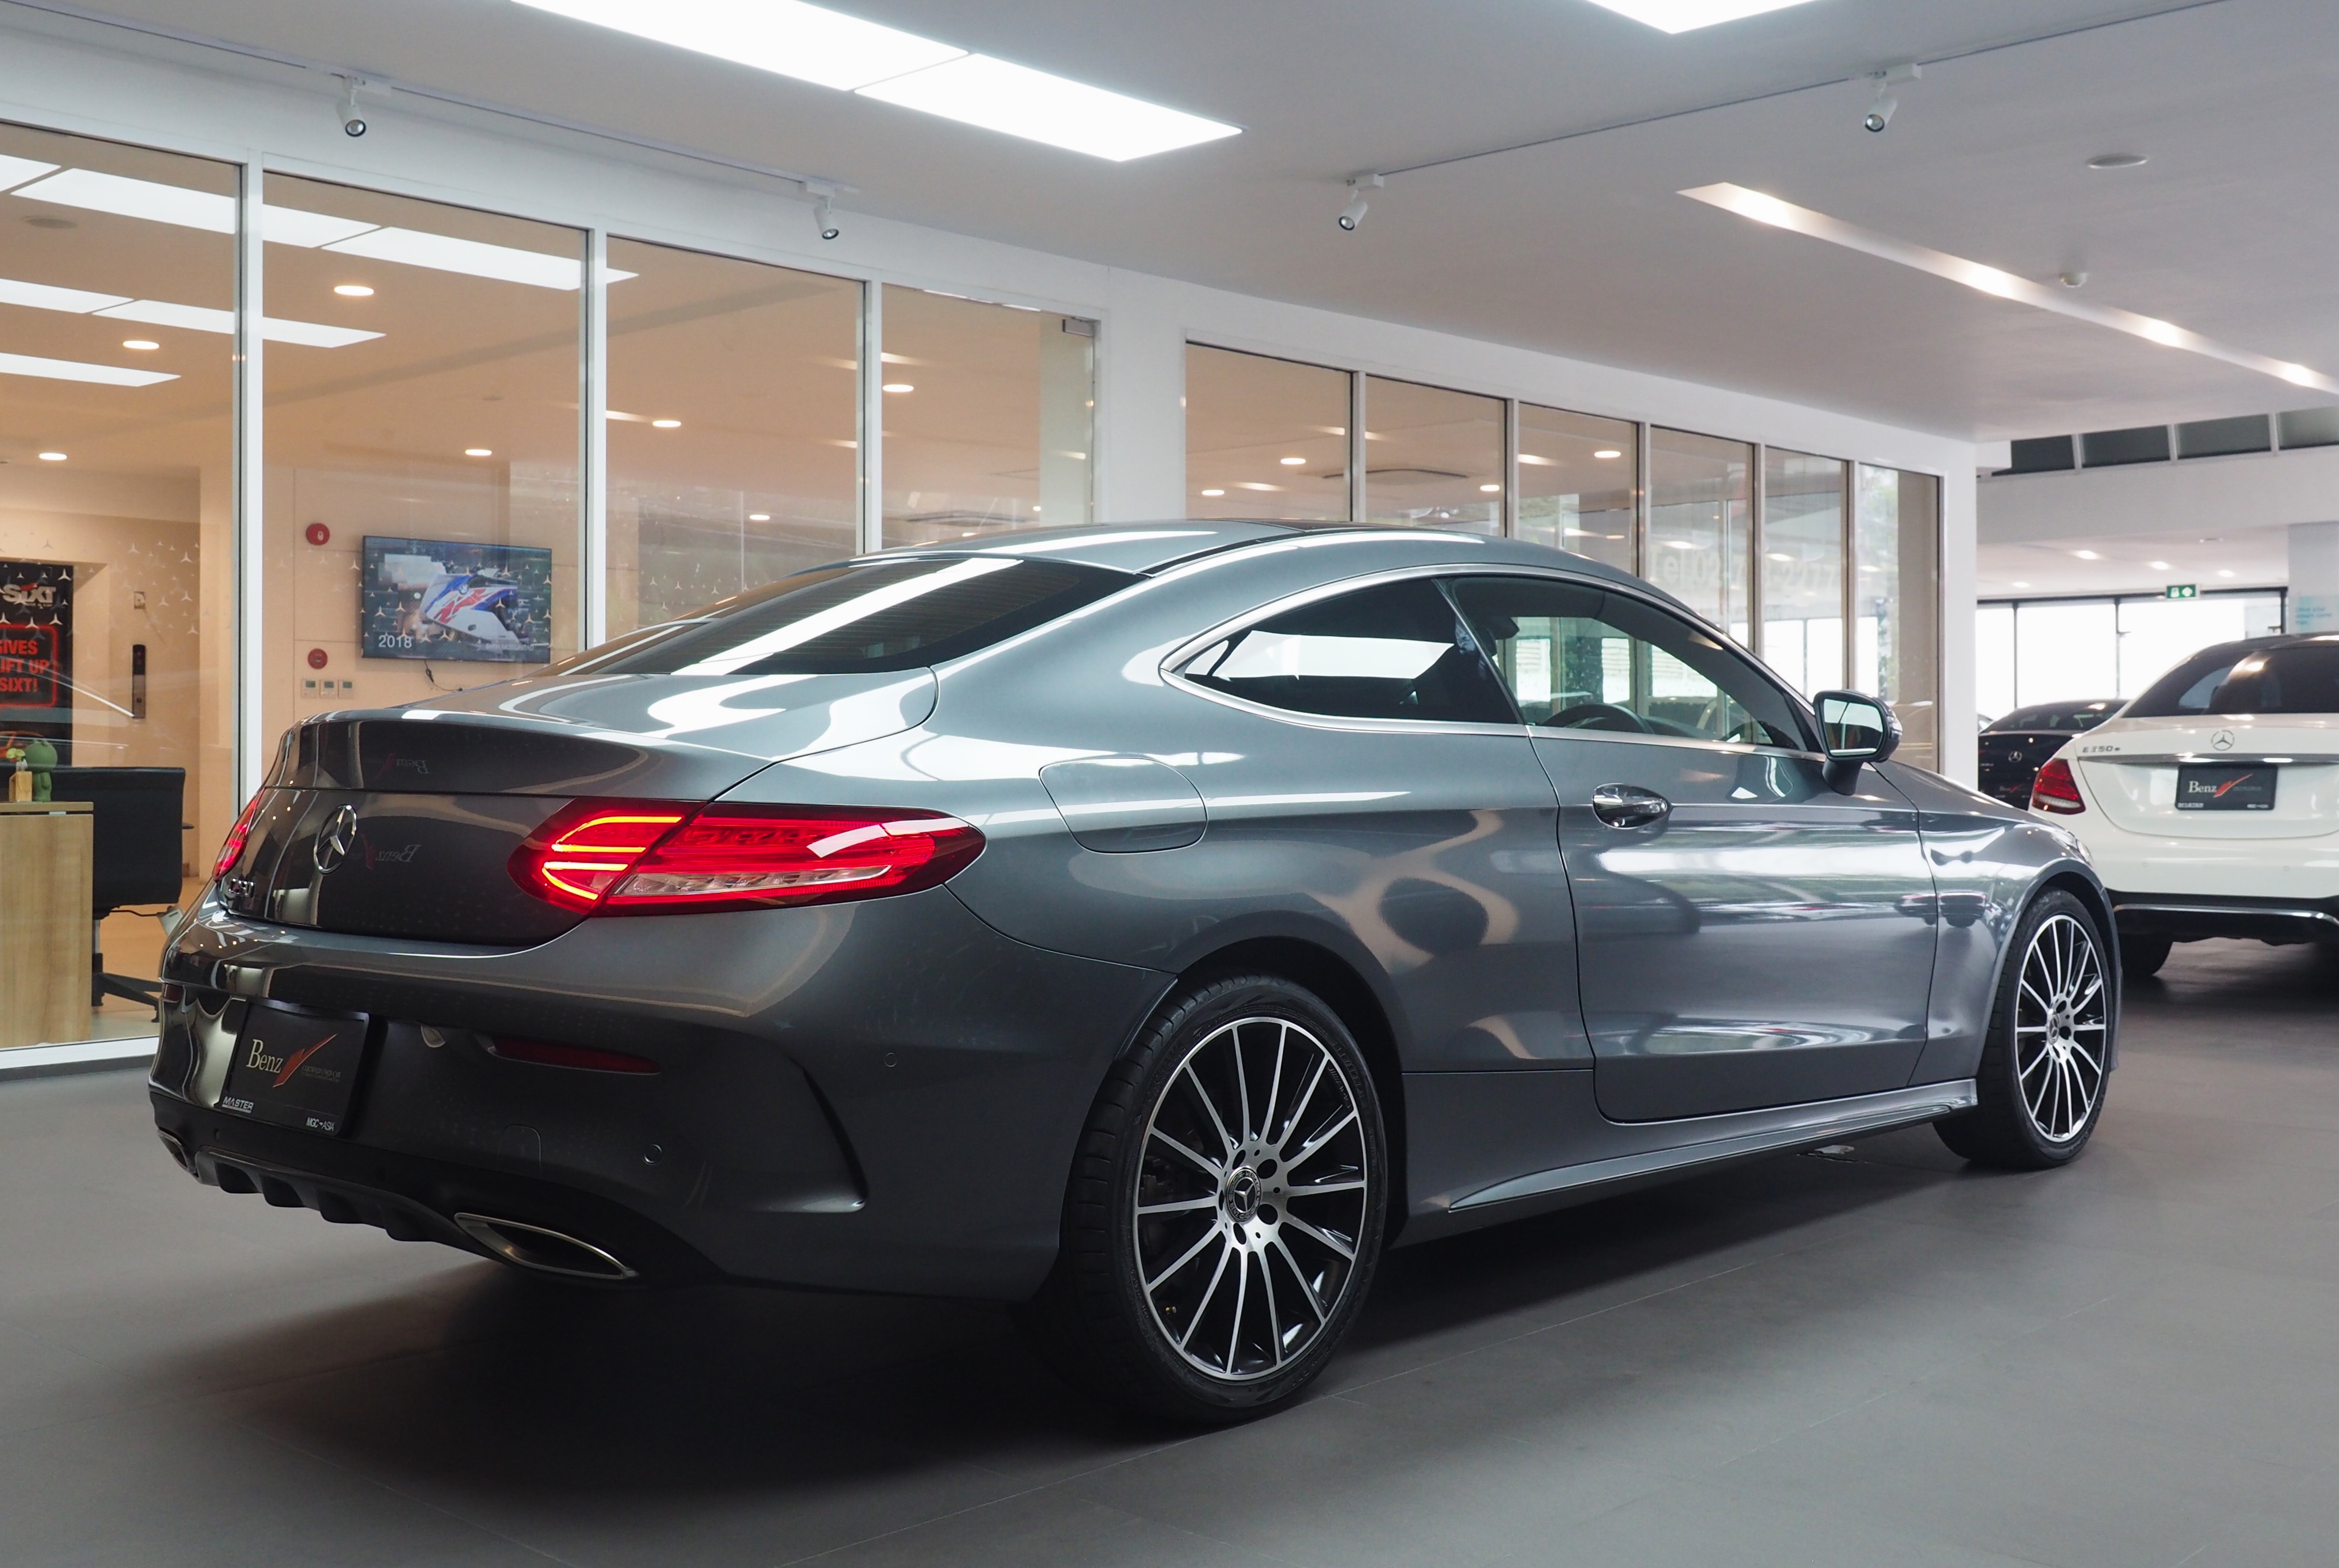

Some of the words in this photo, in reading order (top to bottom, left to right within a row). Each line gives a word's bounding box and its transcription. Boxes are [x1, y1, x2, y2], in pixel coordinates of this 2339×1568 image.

[378, 635, 412, 648] 2018
[0, 658, 23, 673] IFT
[29, 658, 49, 674] UP
[0, 677, 38, 692] SIXT!
[2188, 781, 2217, 793] Benz
[245, 1038, 283, 1073] Benz
[223, 1096, 254, 1110] MASTER
